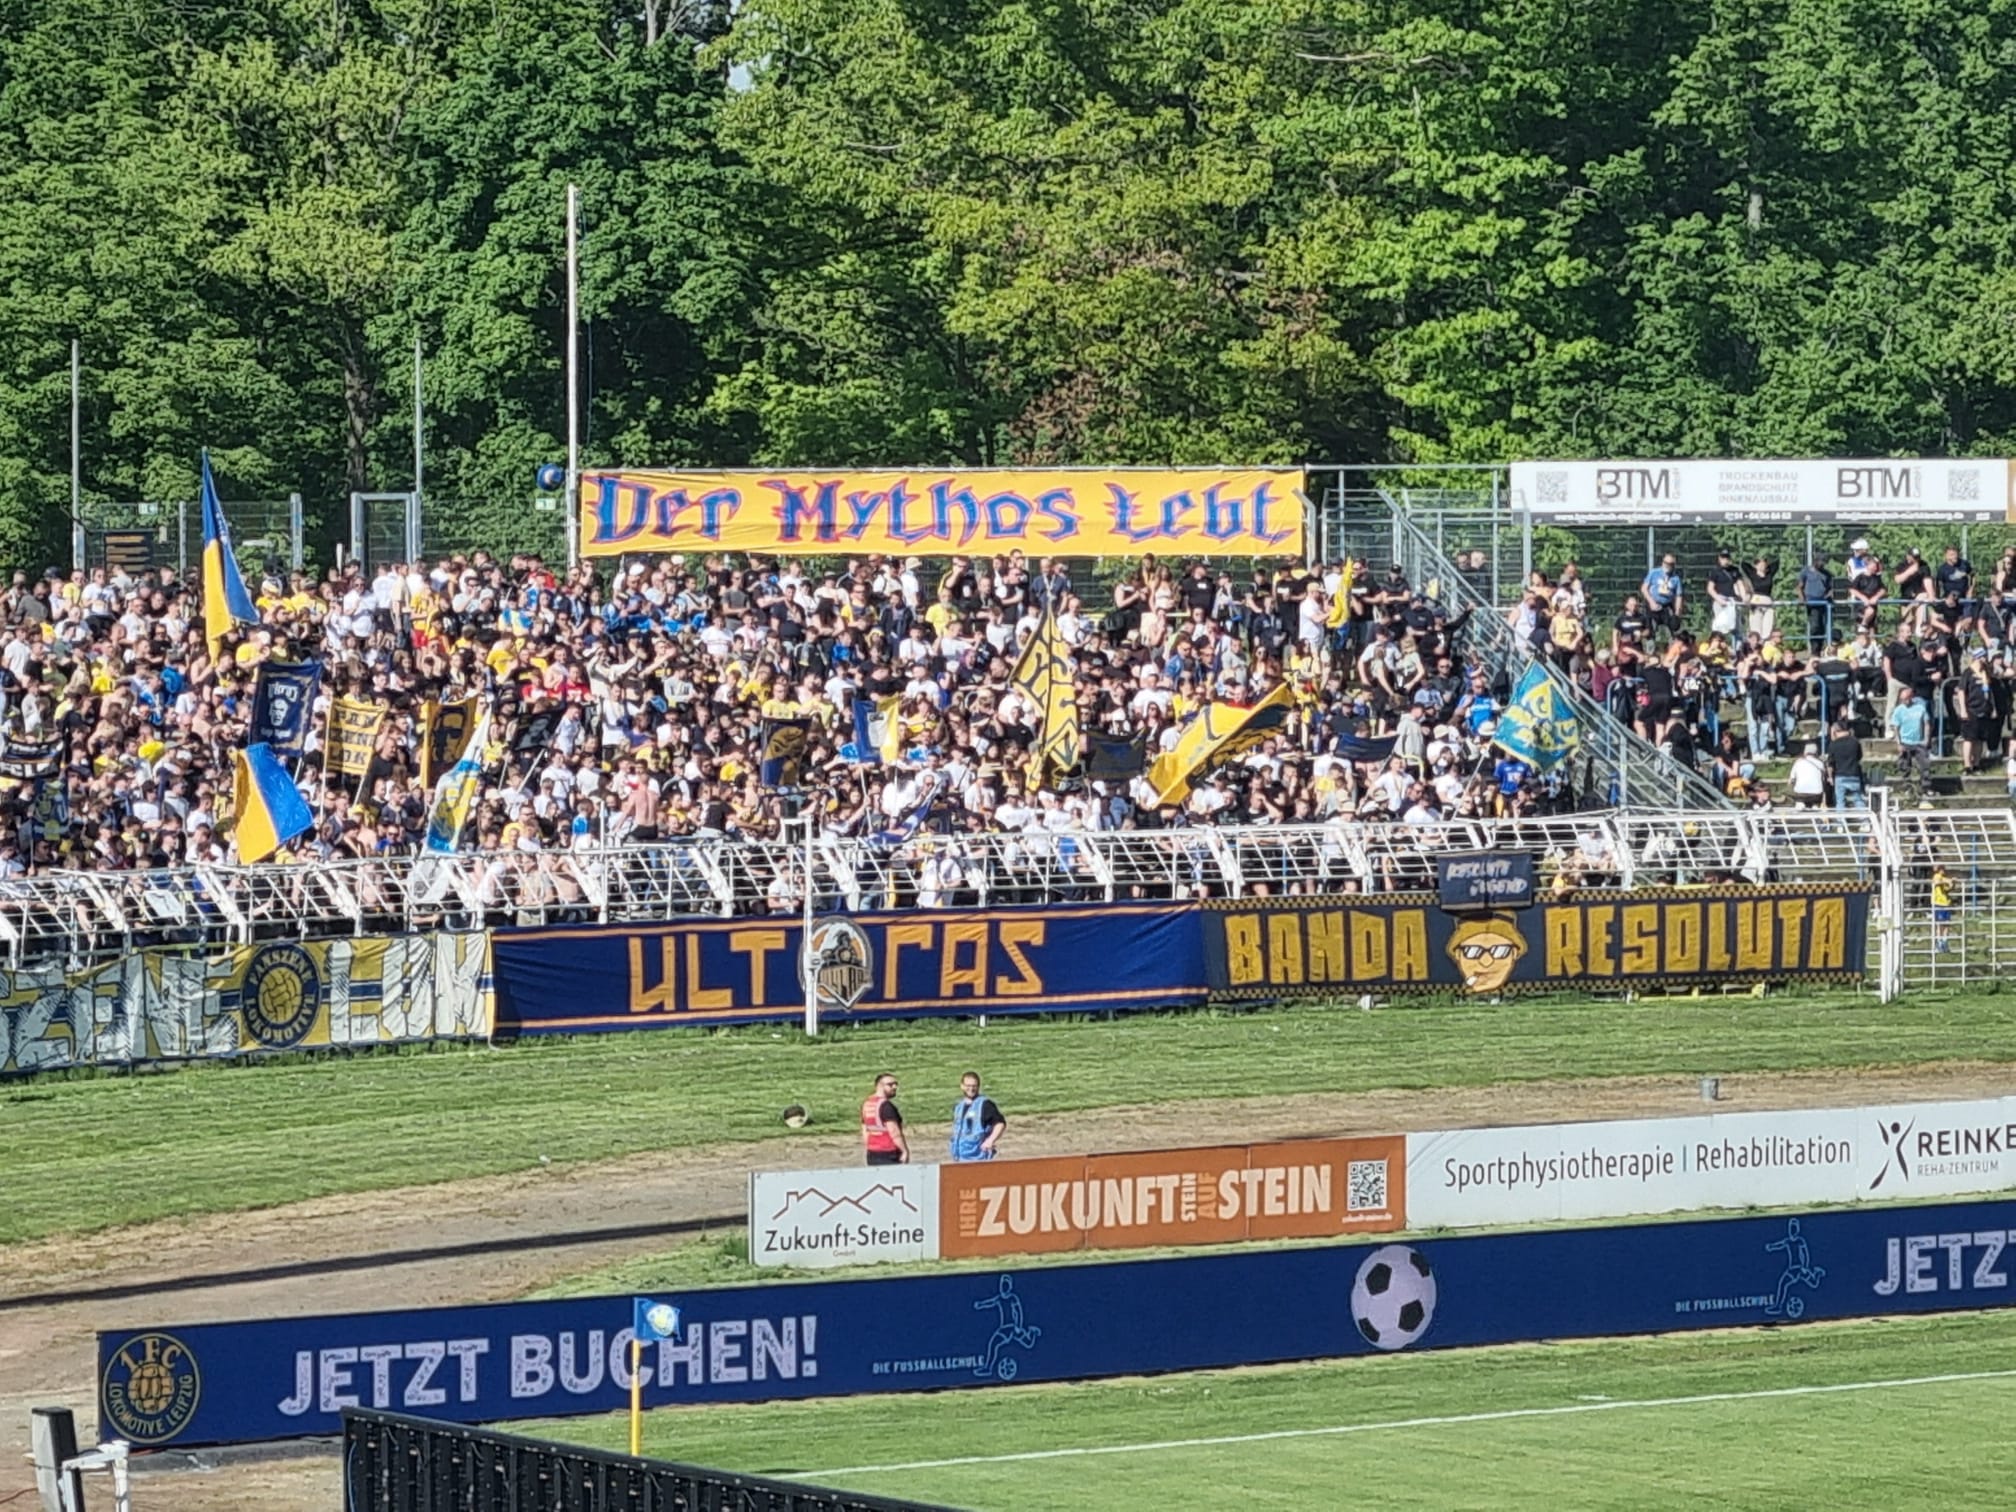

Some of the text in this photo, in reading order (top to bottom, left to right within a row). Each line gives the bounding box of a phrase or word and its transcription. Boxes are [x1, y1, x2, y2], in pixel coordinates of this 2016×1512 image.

[1596, 468, 1670, 499] BTM
[1718, 472, 1799, 481] TROCKENBAU
[1836, 467, 1911, 498] BTM
[583, 475, 742, 544] Der
[757, 478, 1084, 547] Mythos
[1224, 896, 1846, 985] BANDA RESOLUTA
[1444, 1136, 1851, 1192] Sportphysiotherapie Rehabilitation
[1917, 1160, 1999, 1176] REHA-ZENTRUM
[958, 1188, 977, 1237] IHRE
[977, 1174, 1180, 1237] ZUKUNFT
[1181, 1173, 1198, 1223] STEIN
[1198, 1172, 1218, 1220] AUF
[1218, 1164, 1333, 1220] STEIN
[763, 1222, 925, 1253] Zukunft-Steine
[1873, 1230, 2016, 1295] JETZ
[1675, 1294, 1775, 1313] DIE FUSSBALLSCHULE
[277, 1315, 818, 1416] JETZT BUCHEN!
[872, 1356, 985, 1374] DIE FUSSBALLSCHULE
[109, 1375, 195, 1435] LOKOMOTIVE LEIPZIG
